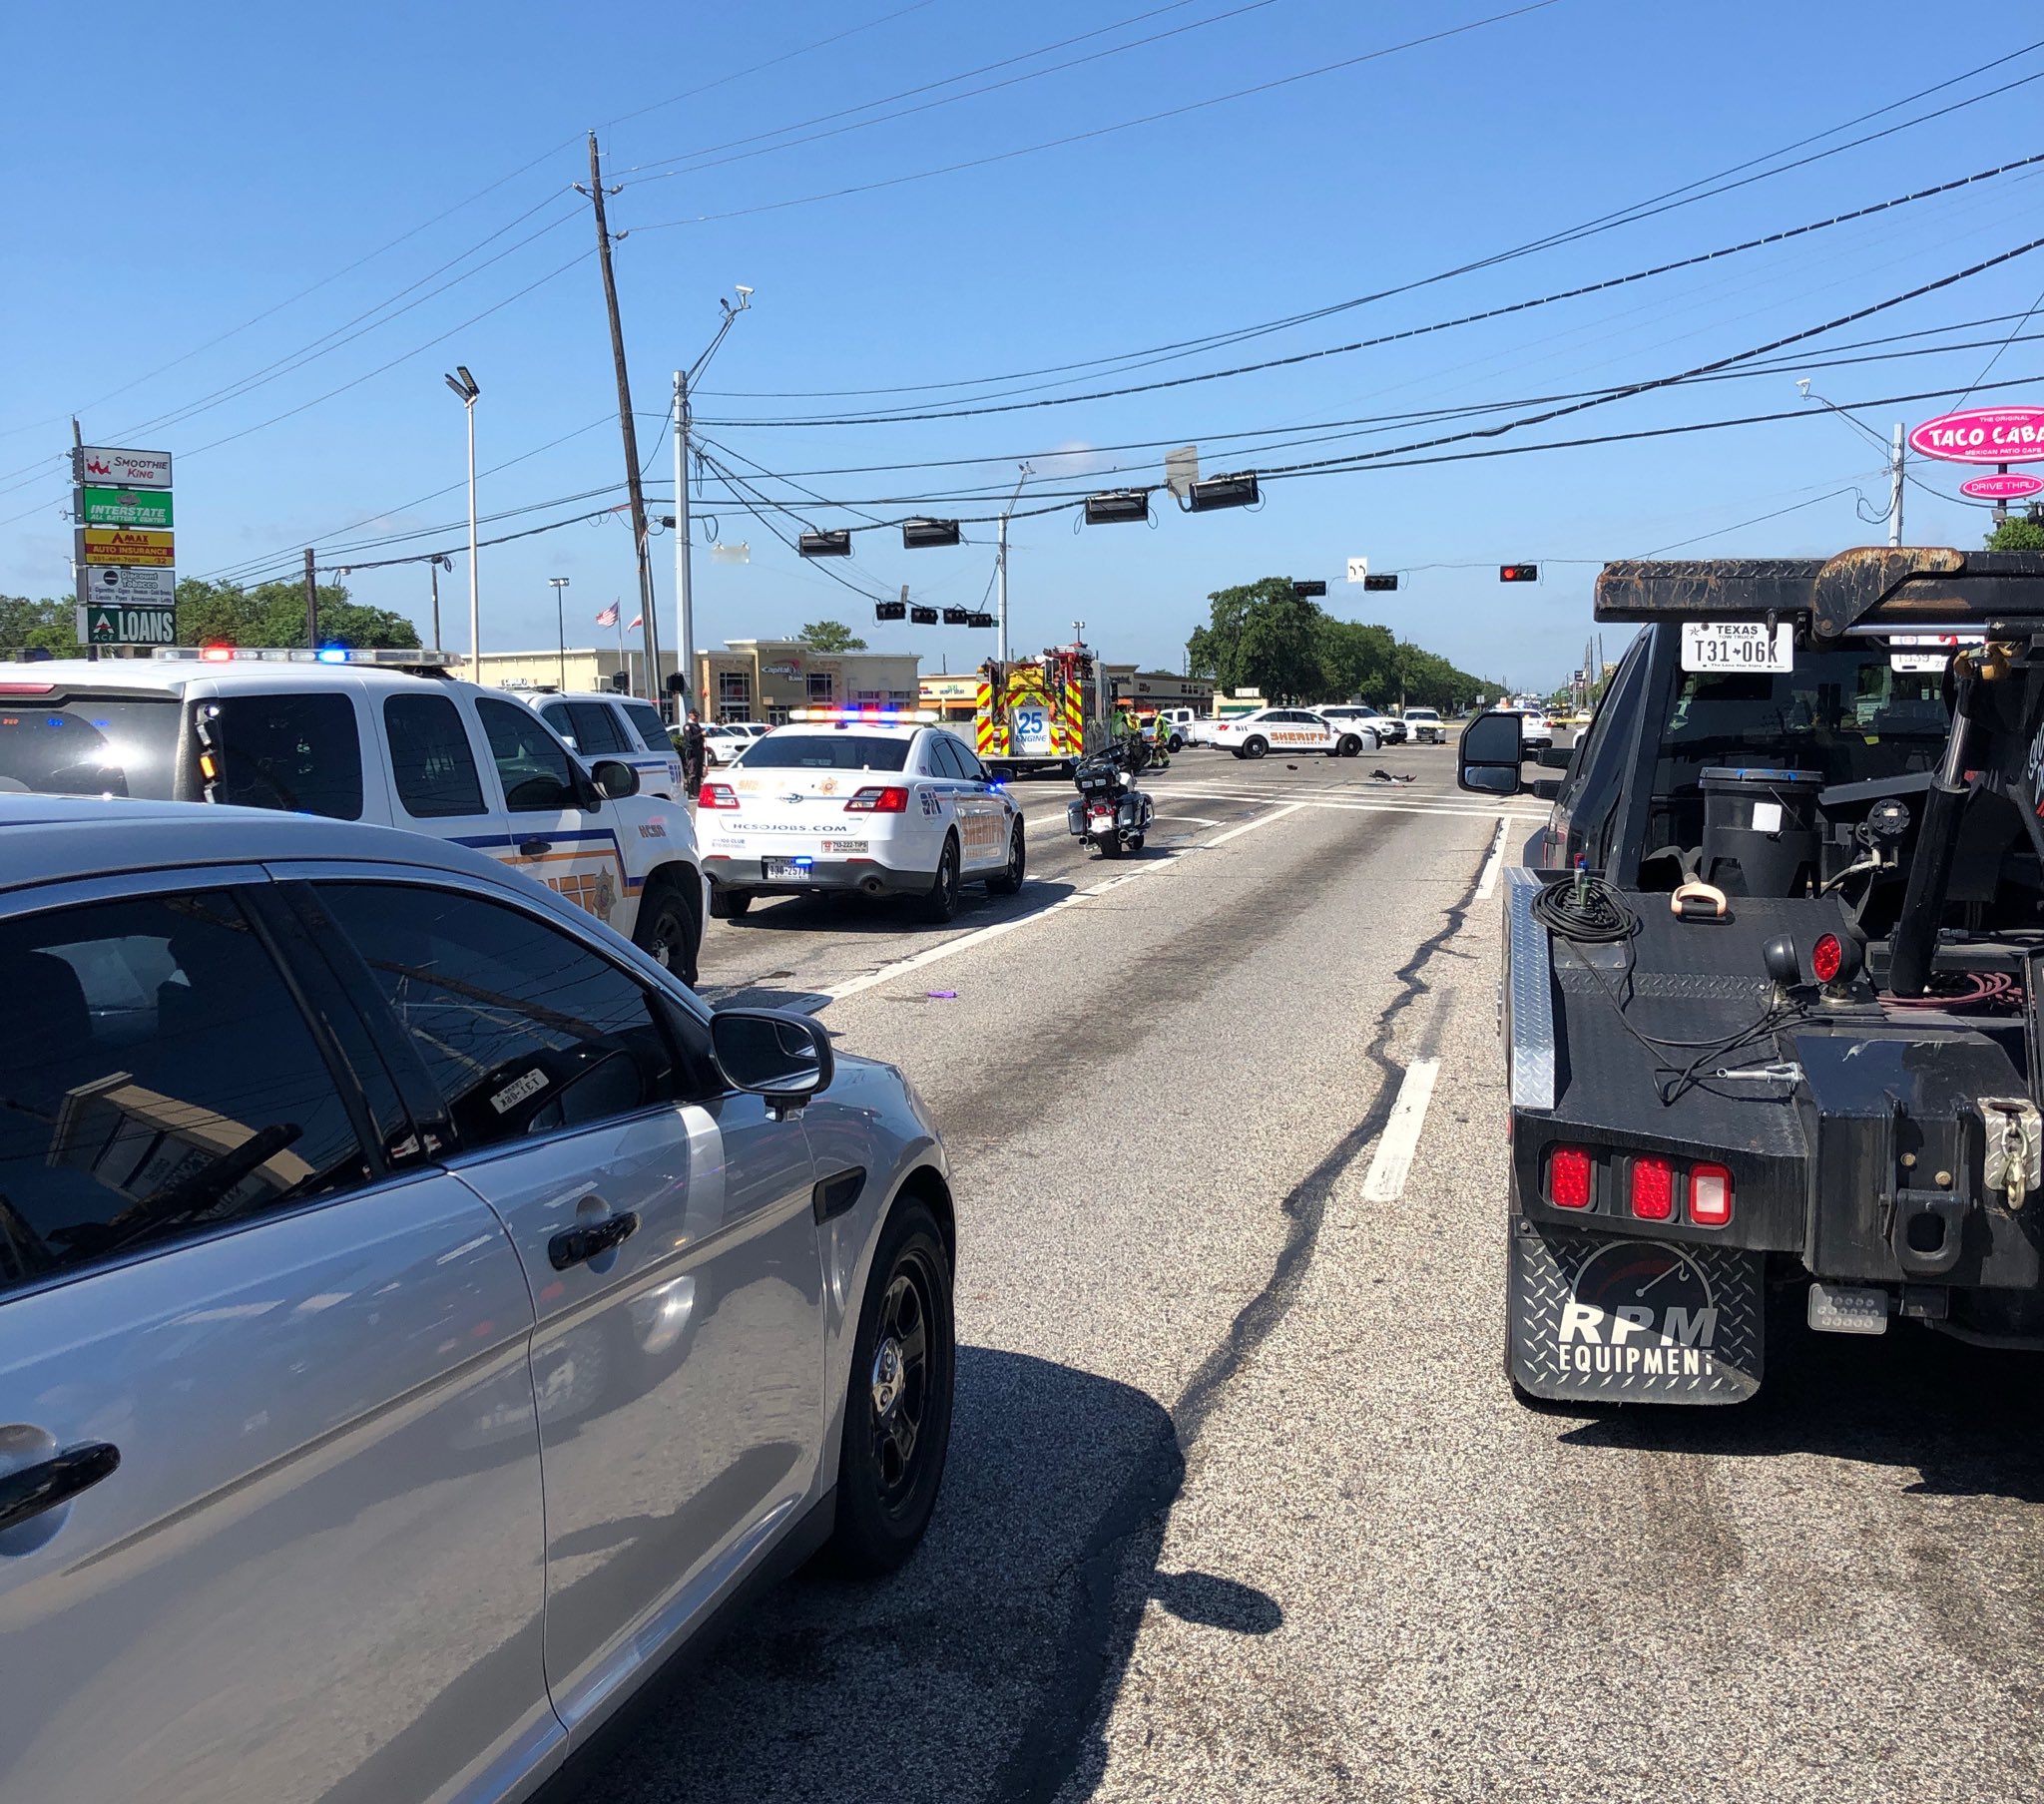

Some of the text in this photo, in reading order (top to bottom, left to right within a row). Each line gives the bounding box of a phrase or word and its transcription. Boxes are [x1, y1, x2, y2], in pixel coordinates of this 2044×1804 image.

[1928, 428, 1984, 447] TACO
[1972, 479, 2034, 491] DRIVE THRU
[90, 505, 166, 517] INTERSTATE
[121, 571, 158, 580] Discount
[123, 580, 158, 589] Tobacco
[119, 611, 174, 643] LOANS
[1716, 626, 1758, 635] TEXAS
[1019, 712, 1043, 733] 25
[1270, 732, 1323, 741] SHERIFF
[1558, 1302, 1719, 1347] RPM
[1559, 1345, 1715, 1375] EQUIPMENT
